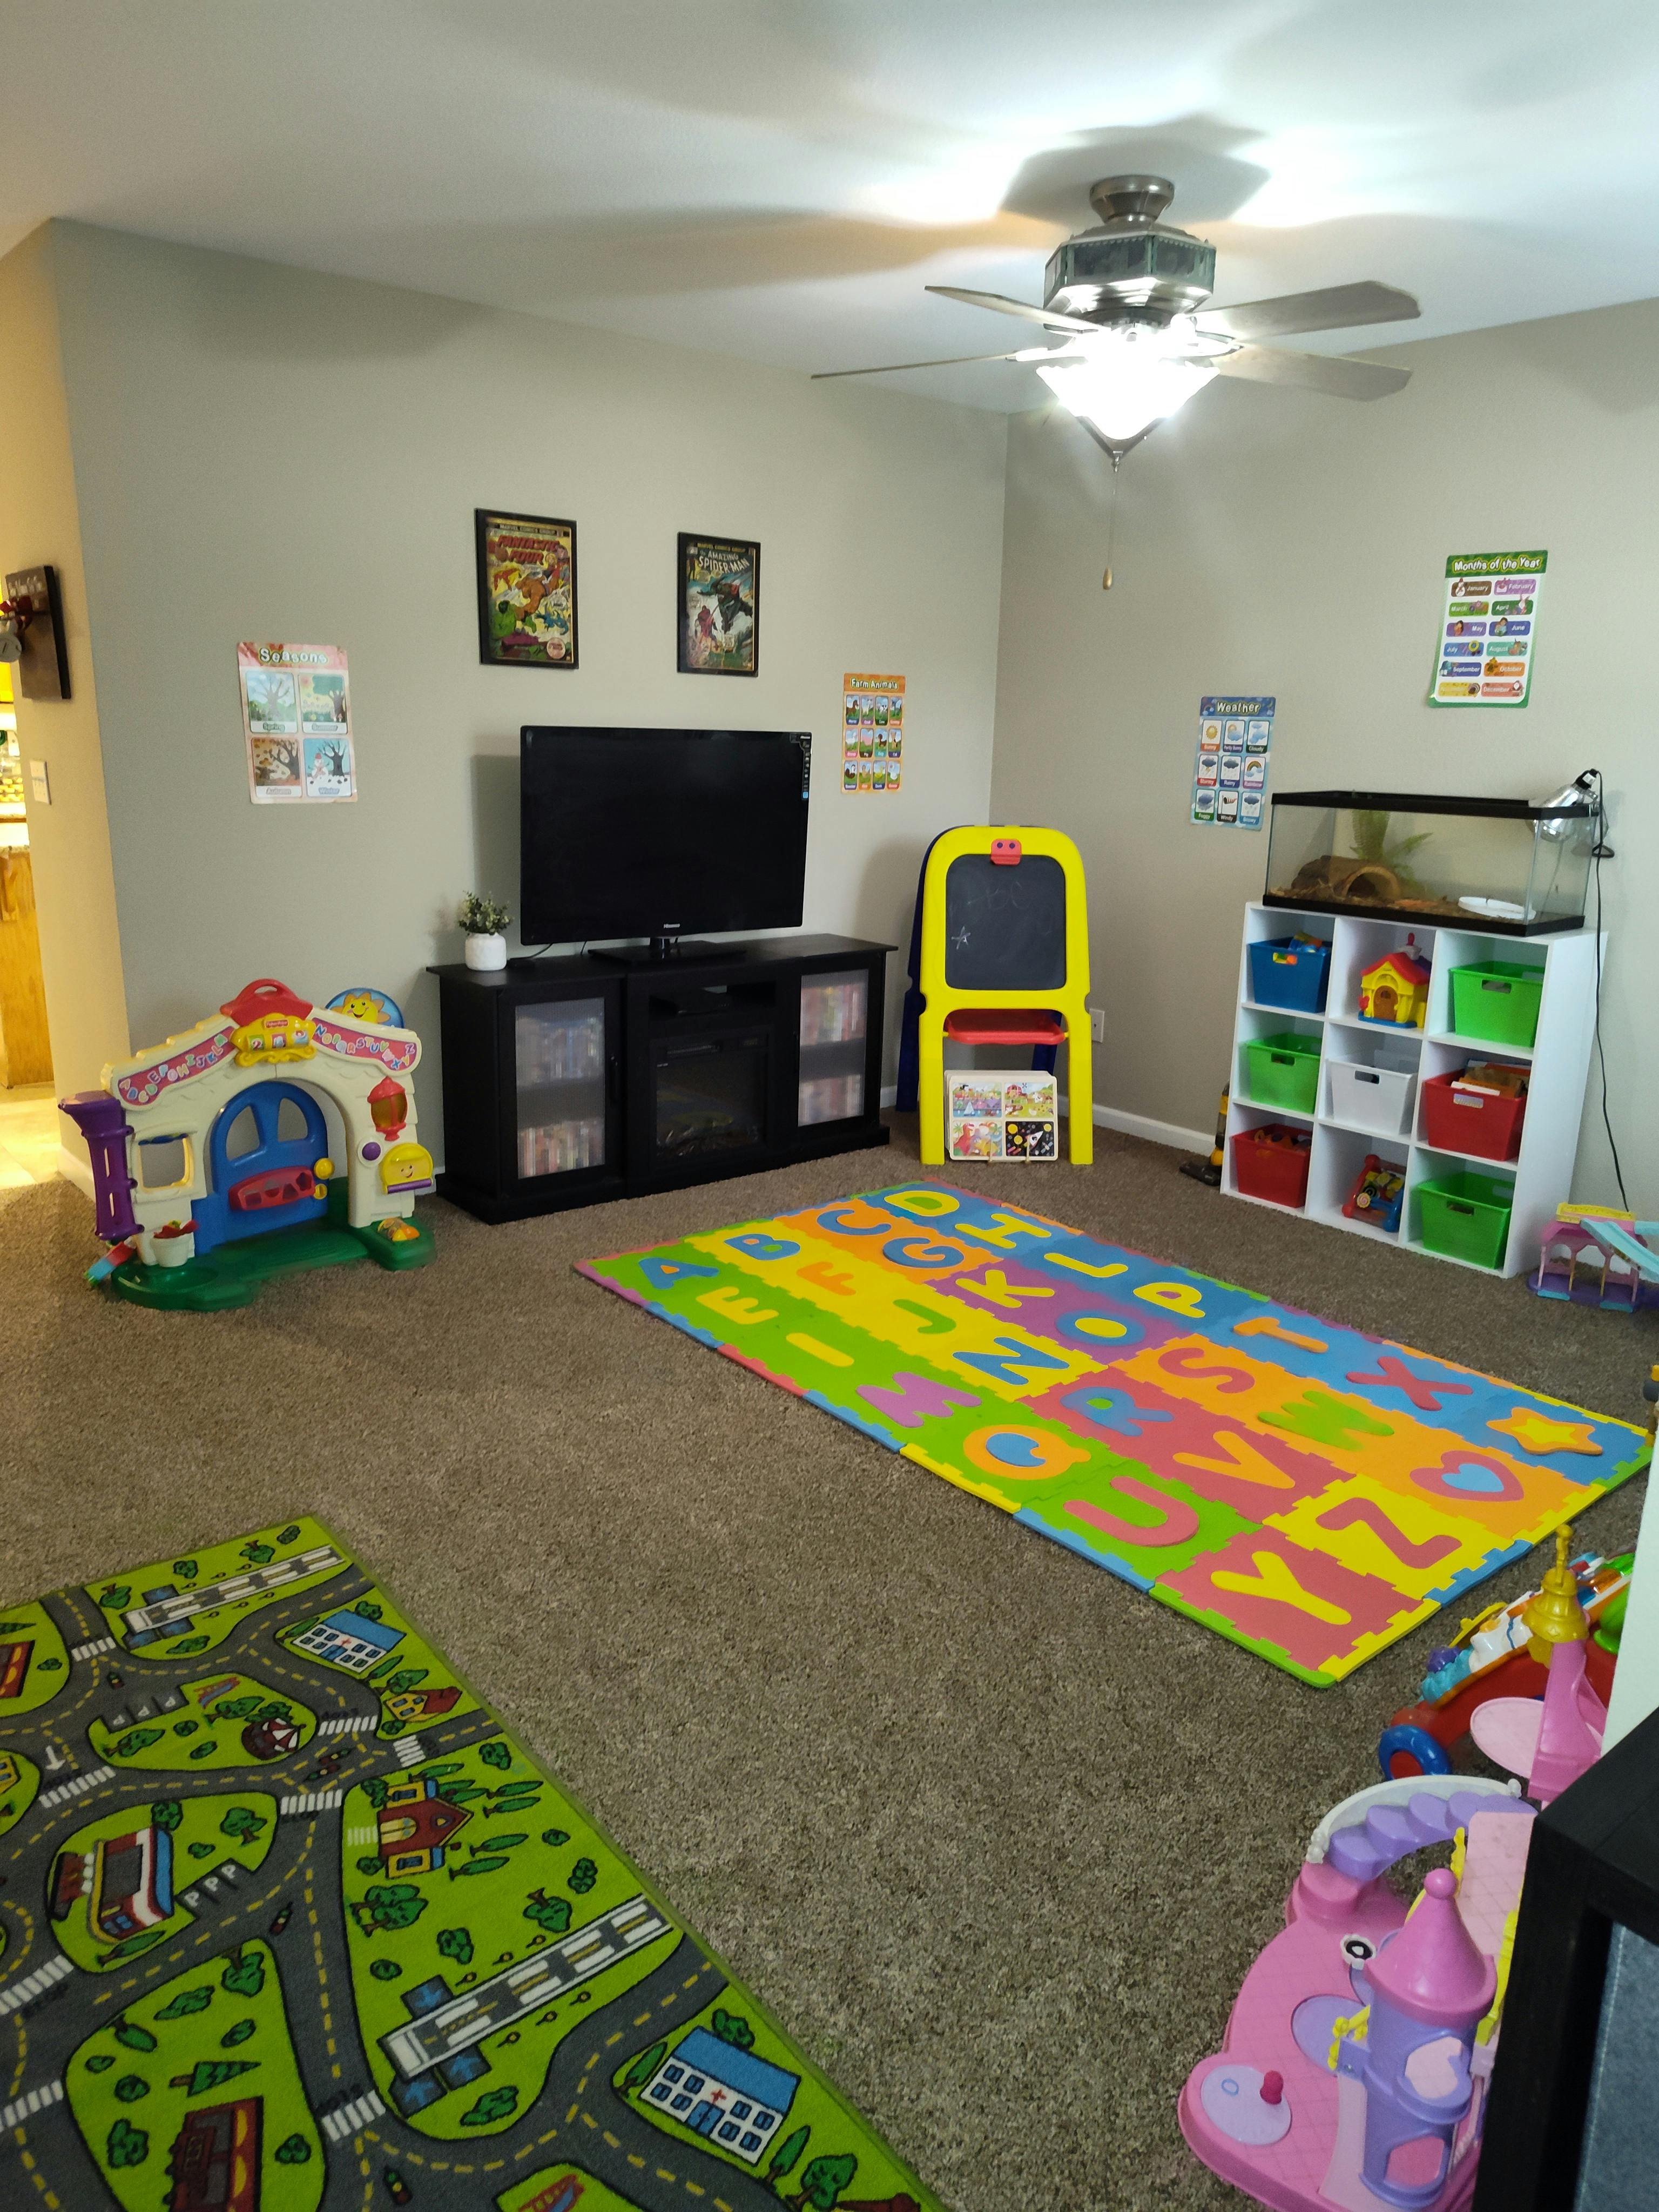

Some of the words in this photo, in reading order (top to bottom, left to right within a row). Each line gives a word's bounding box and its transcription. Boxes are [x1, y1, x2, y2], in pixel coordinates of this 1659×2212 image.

[510, 550, 544, 565] FOUR
[708, 550, 739, 561] AMAZING
[1454, 560, 1487, 571] Months
[1489, 558, 1500, 570] of
[1502, 558, 1517, 570] the
[1520, 557, 1540, 568] Year
[260, 648, 327, 664] Seasons
[851, 678, 868, 688] Farm
[871, 680, 898, 689] Animals
[1217, 702, 1259, 713] Weather
[638, 1257, 719, 1290] A
[724, 1233, 800, 1261] B
[817, 1209, 892, 1236] C
[884, 1190, 960, 1217] D
[695, 1286, 779, 1325] E
[796, 1261, 857, 1296] F
[882, 1237, 965, 1269] G
[954, 1213, 1051, 1249] H
[893, 1299, 956, 1334] J
[955, 1270, 1055, 1309] K
[1044, 1253, 1128, 1278] L
[855, 1372, 982, 1428] M
[953, 1337, 1070, 1386] N
[1055, 1310, 1147, 1347] O
[1133, 1282, 1206, 1318] P
[963, 1424, 1091, 1480] Q
[1060, 1386, 1174, 1437] R
[1157, 1348, 1255, 1394] S
[1233, 1317, 1327, 1353] T
[1063, 1476, 1200, 1547] U
[1173, 1430, 1297, 1489] V
[1257, 1391, 1395, 1452] W
[1346, 1356, 1473, 1411] X
[1211, 1551, 1352, 1626] Y
[1316, 1498, 1462, 1569] Z
[184, 1891, 200, 1908] P
[204, 1877, 219, 1892] P
[221, 1865, 236, 1879] P
